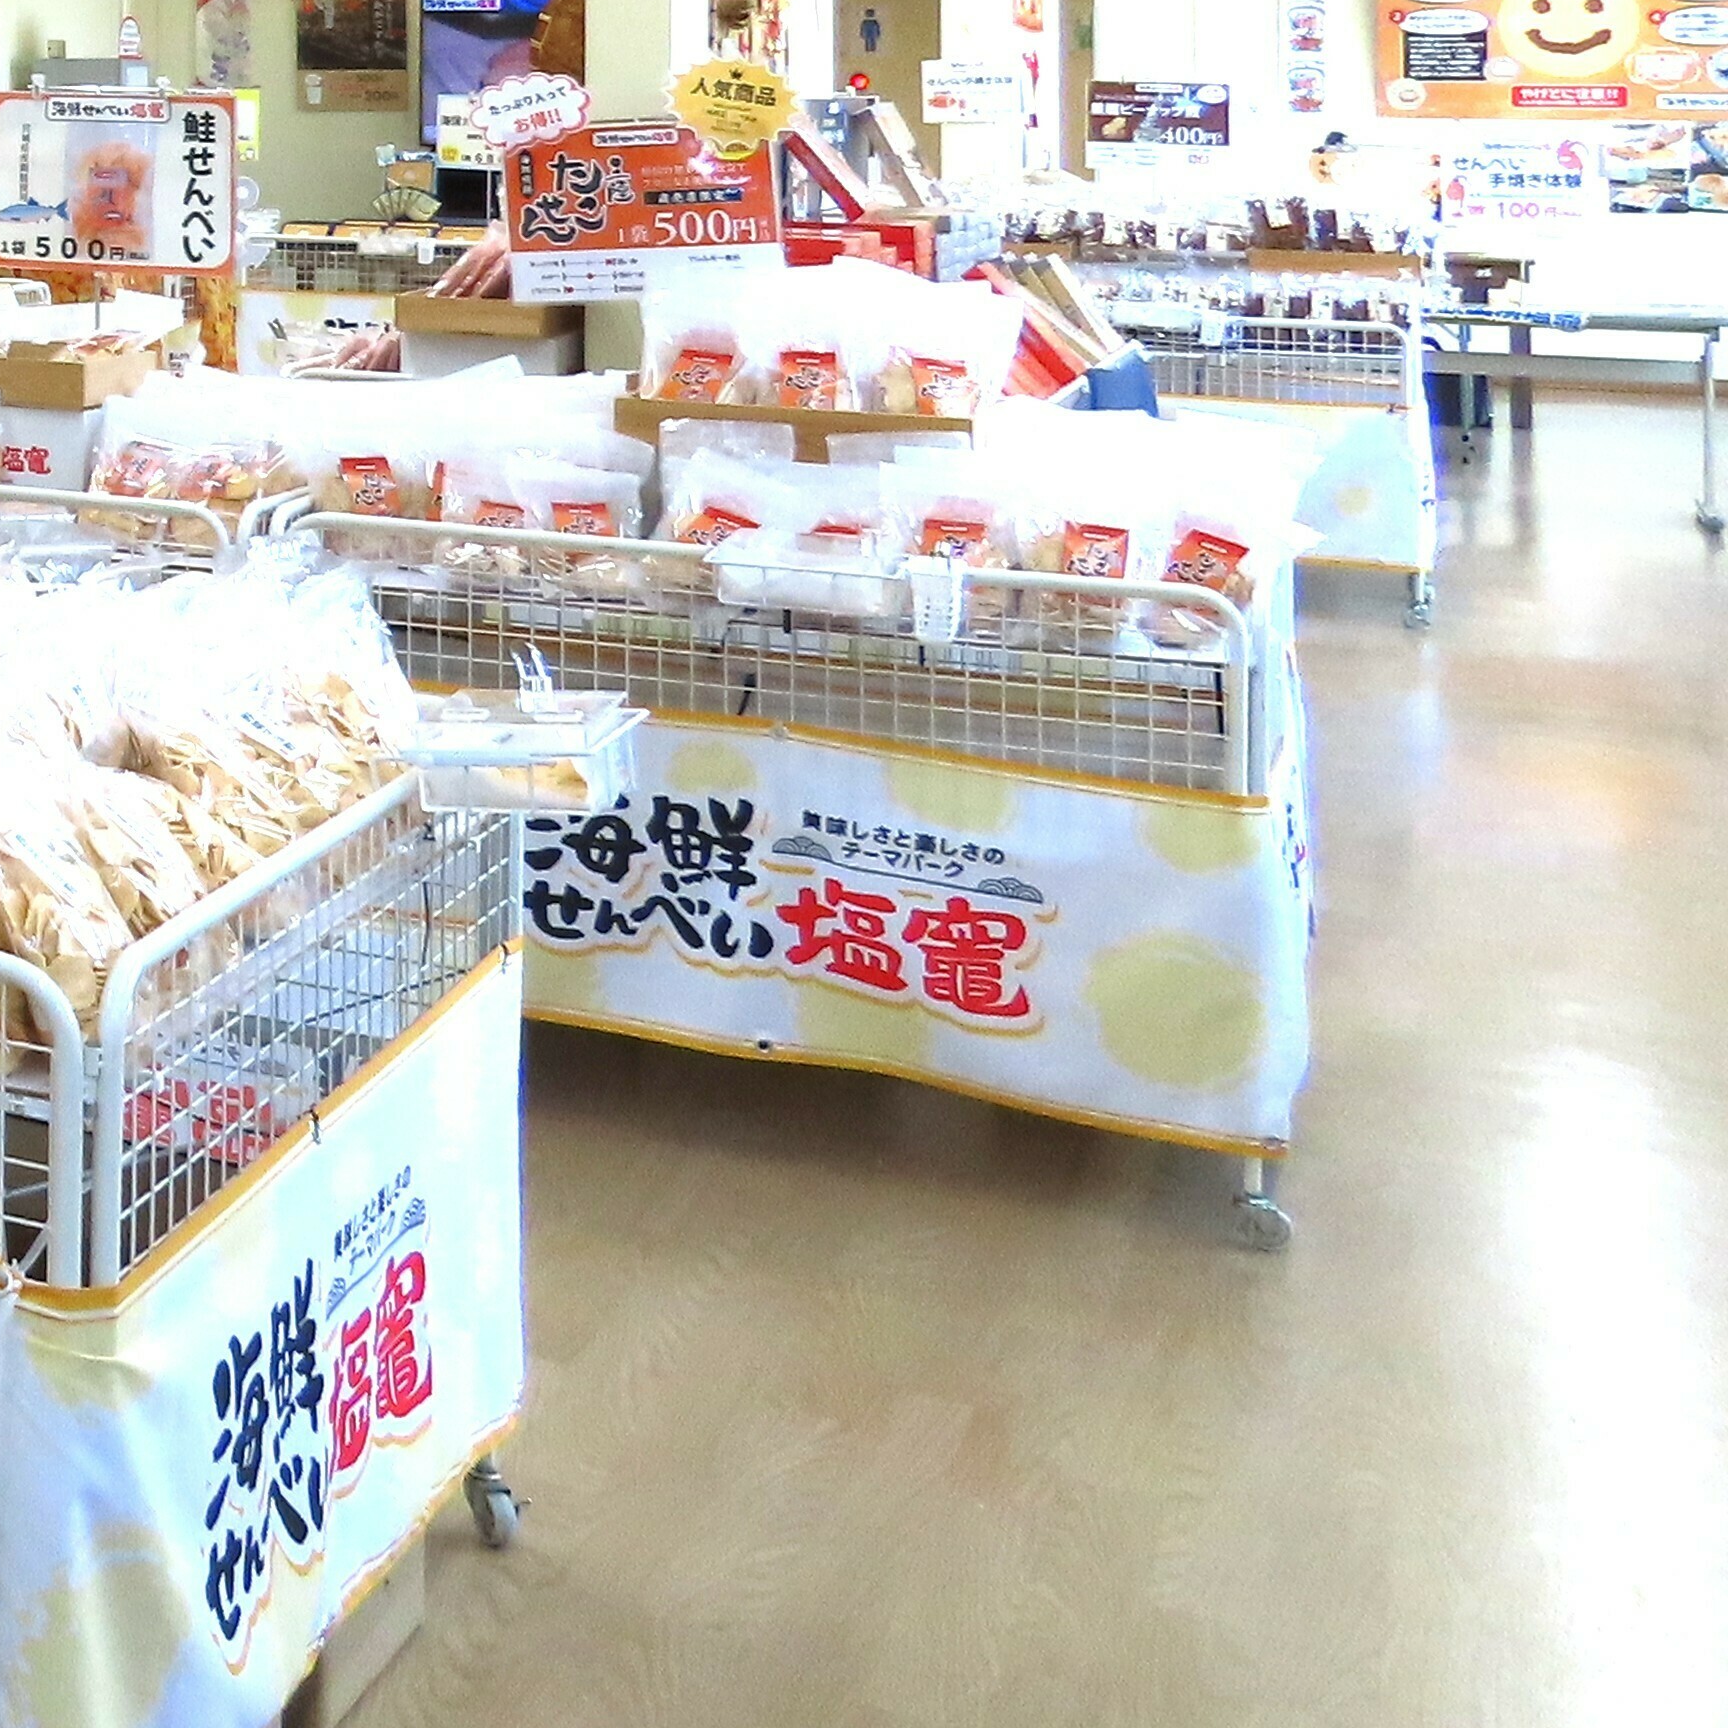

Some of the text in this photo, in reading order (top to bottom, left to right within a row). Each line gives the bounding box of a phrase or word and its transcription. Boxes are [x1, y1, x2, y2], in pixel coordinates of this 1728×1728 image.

[690, 76, 777, 106] 人気商品
[181, 110, 217, 264] 鮭せんべい
[34, 236, 126, 262] 500円
[652, 209, 757, 246] 500円
[524, 796, 758, 903] 海鮮
[801, 809, 1006, 868] 美味しさと楽しさの
[841, 843, 967, 879] テーマパーク
[523, 879, 774, 959] せんべい
[773, 878, 1031, 1019] 塩竈
[205, 1257, 324, 1531] 海鮮
